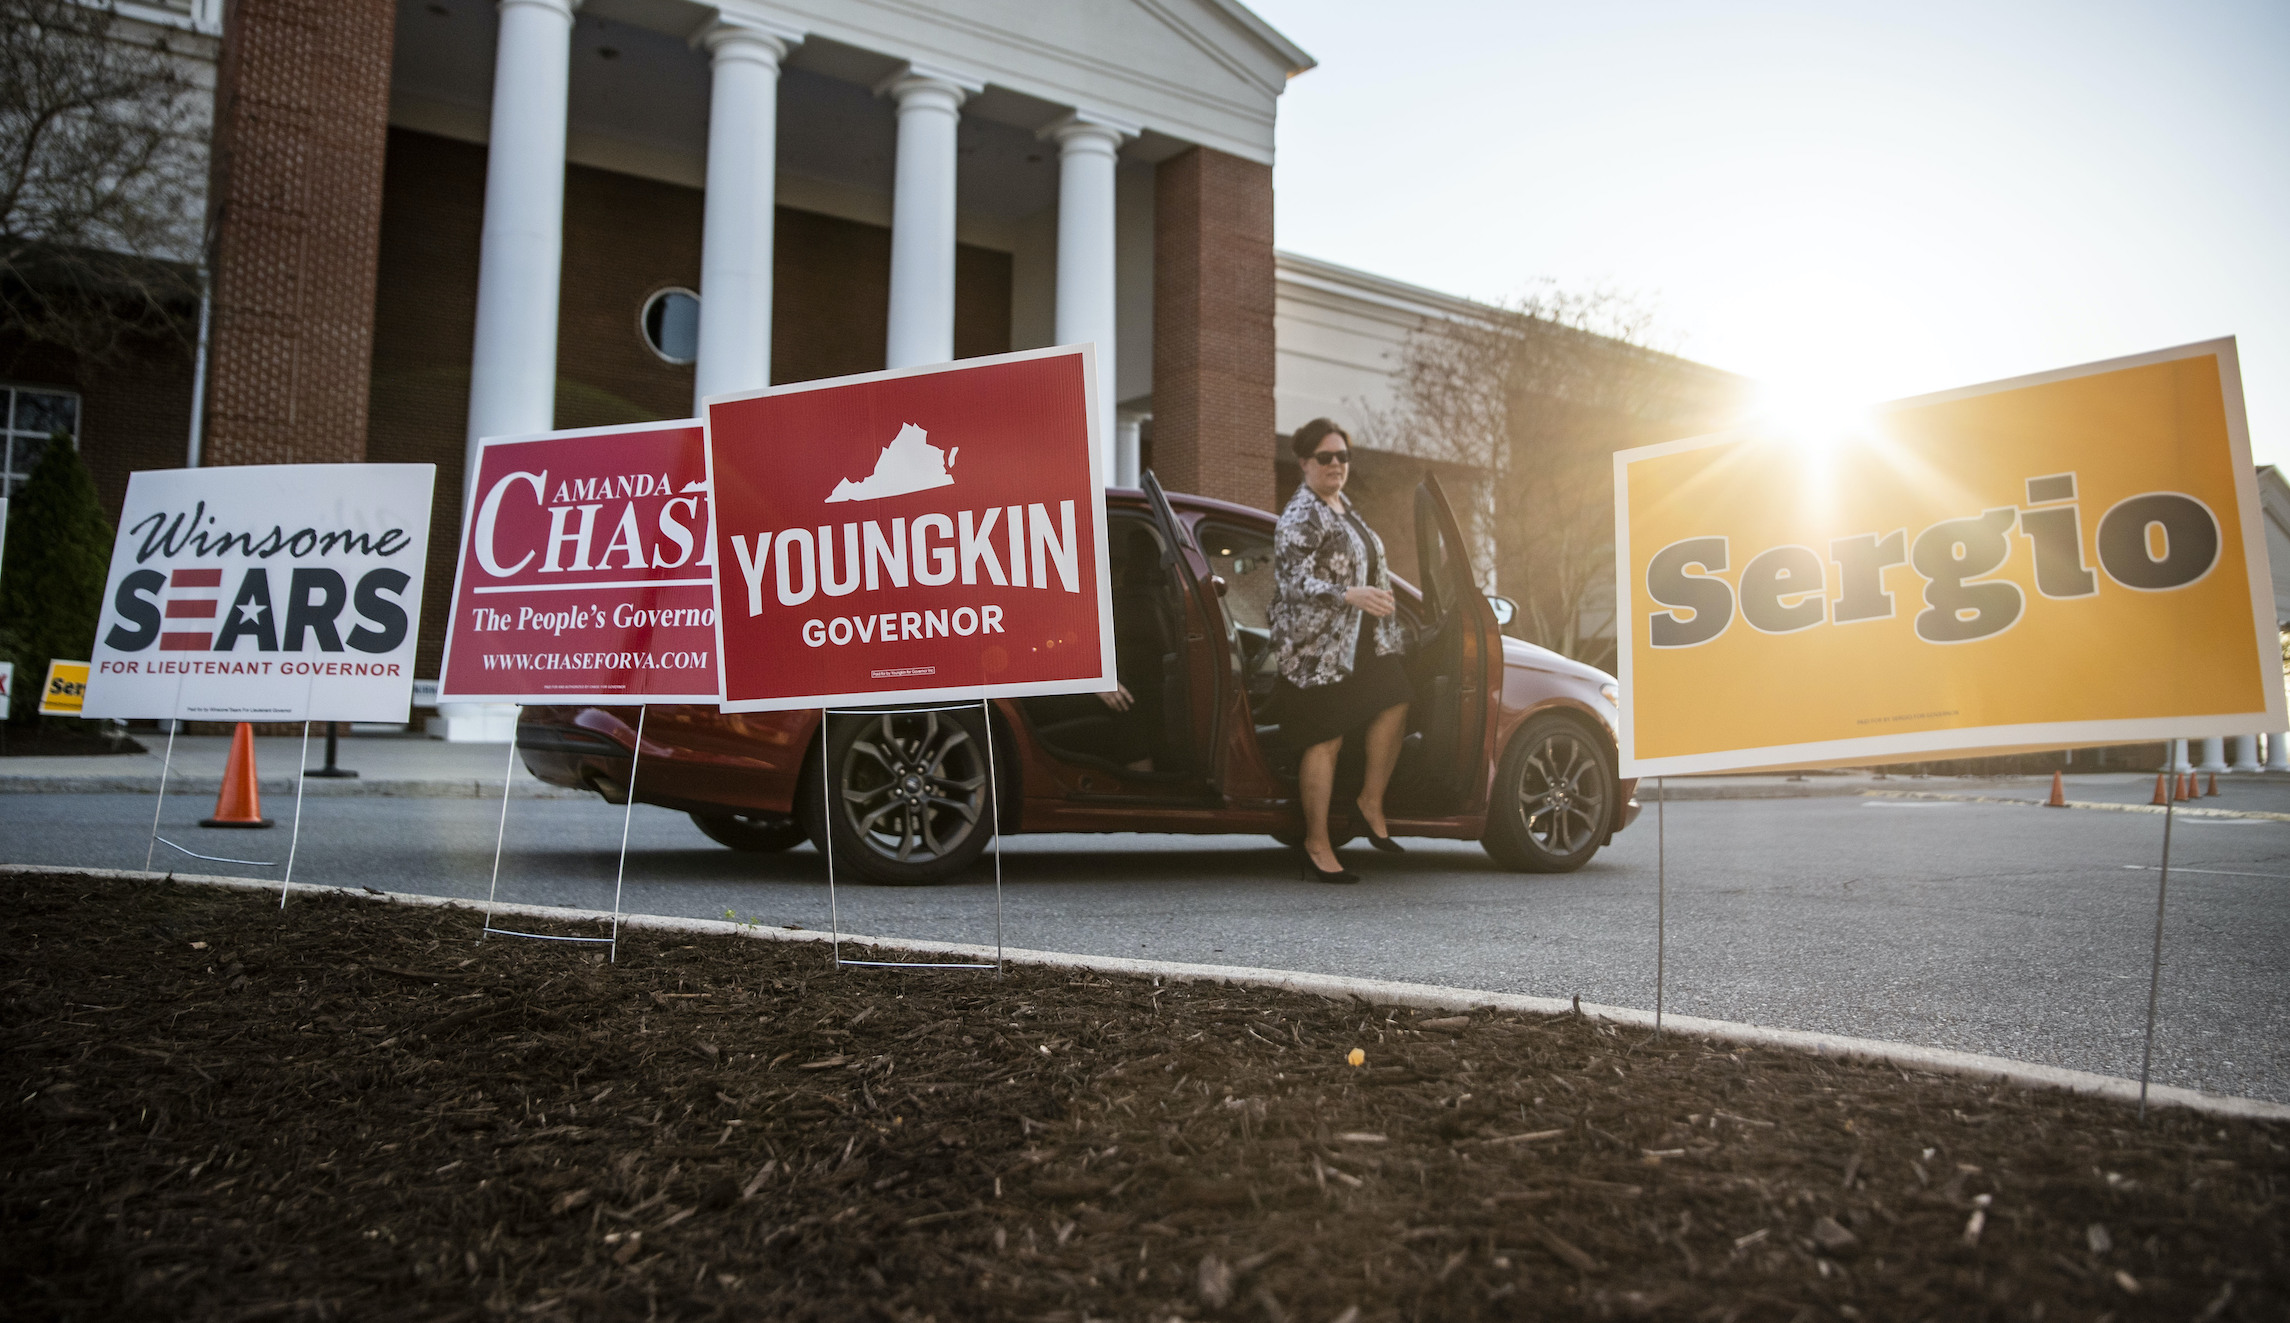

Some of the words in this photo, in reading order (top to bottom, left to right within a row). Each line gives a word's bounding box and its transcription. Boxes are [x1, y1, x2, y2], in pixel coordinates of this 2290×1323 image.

[552, 472, 673, 503] AMANDA
[129, 499, 411, 564] Winsome
[730, 499, 1080, 618] YOUNGKIN
[1646, 471, 2223, 649] Sergio
[103, 567, 411, 654] SEARS
[472, 607, 511, 632] The
[516, 604, 606, 636] People's
[613, 603, 715, 629] Governo
[802, 605, 1005, 648] GOVERNOR
[99, 661, 139, 675] FOR
[146, 661, 272, 675] LIEUTENANT
[280, 662, 400, 677] GOVERNOR
[482, 651, 708, 671] WWW.CHASEFORVA.COM
[49, 677, 86, 697] Ser
